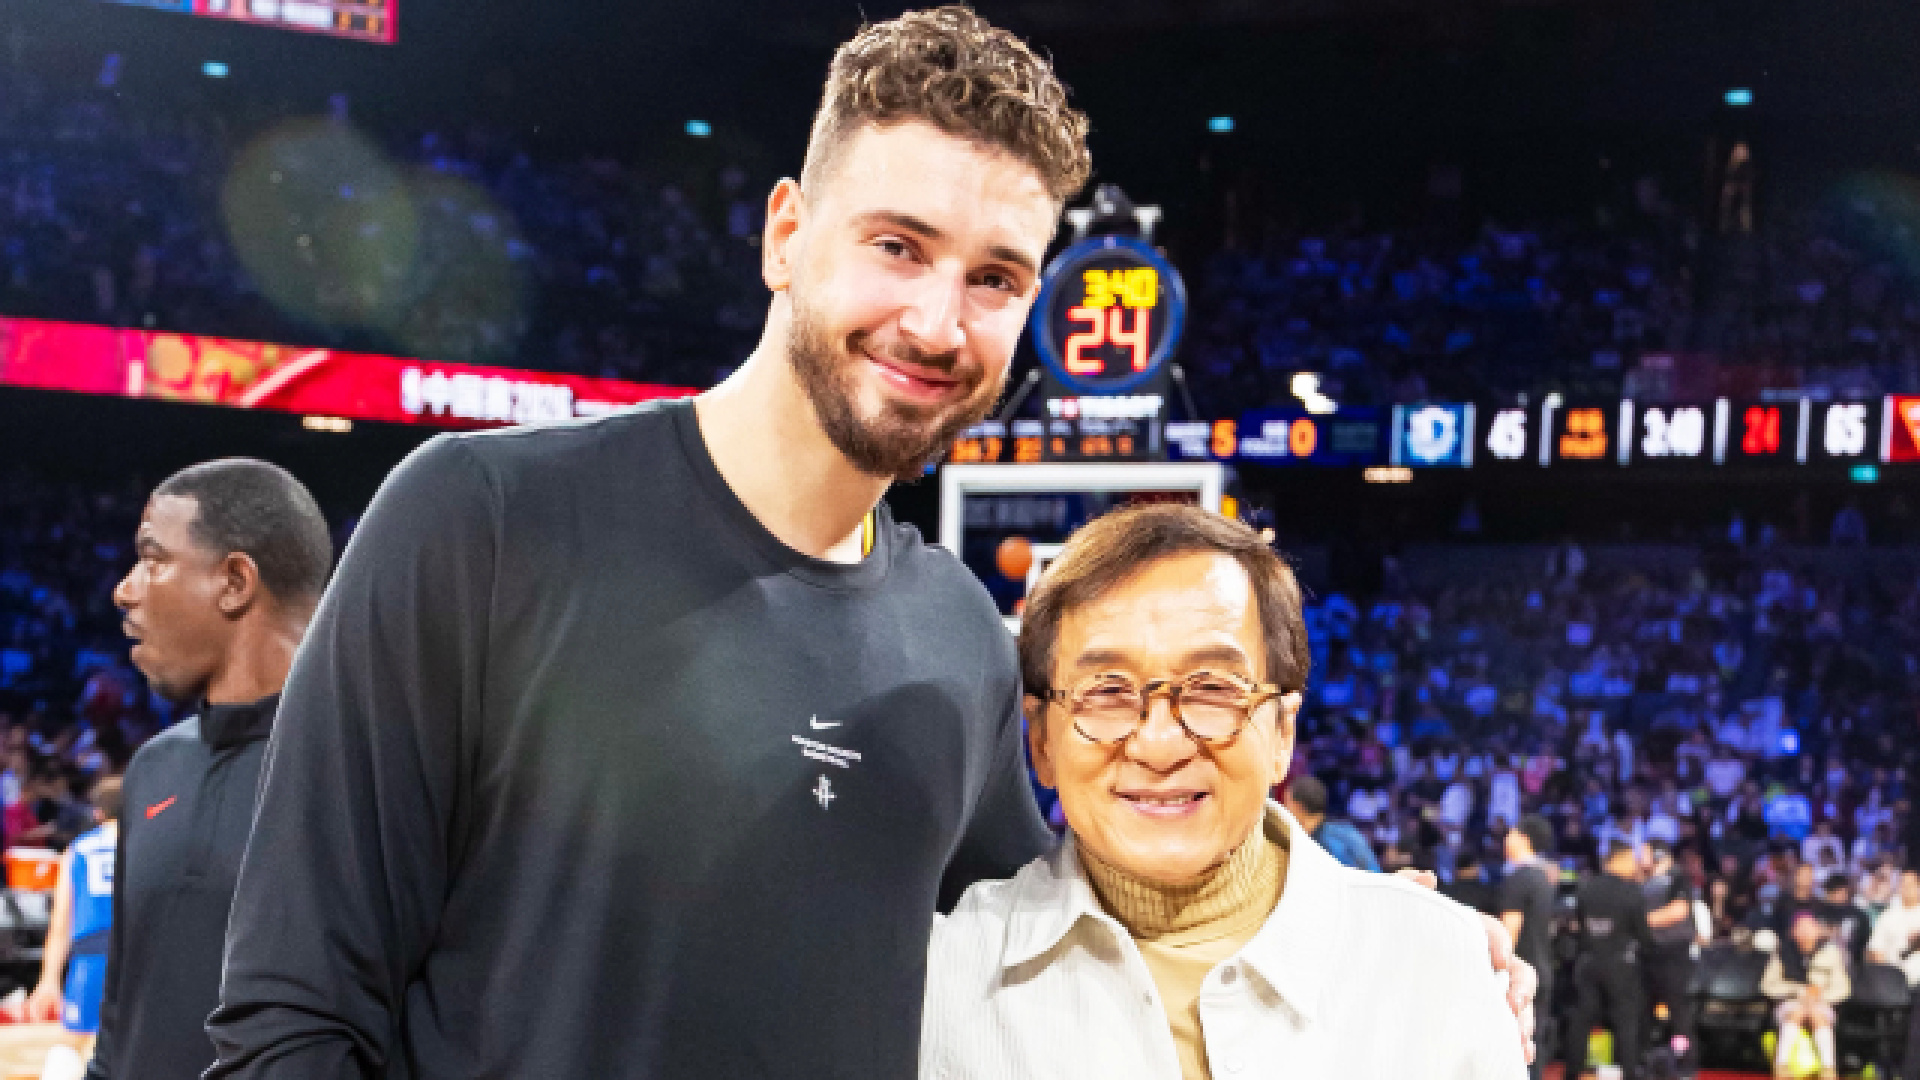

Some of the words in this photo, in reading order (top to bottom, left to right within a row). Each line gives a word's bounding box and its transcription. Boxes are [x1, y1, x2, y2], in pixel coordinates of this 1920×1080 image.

[1082, 267, 1158, 309] 3:40
[1065, 305, 1150, 375] 24
[1211, 419, 1237, 458] 5
[1290, 419, 1318, 458] 0
[1487, 410, 1528, 460] 45
[1642, 407, 1705, 457] 3:40
[1742, 407, 1780, 454] 24
[1824, 405, 1868, 457] 65
